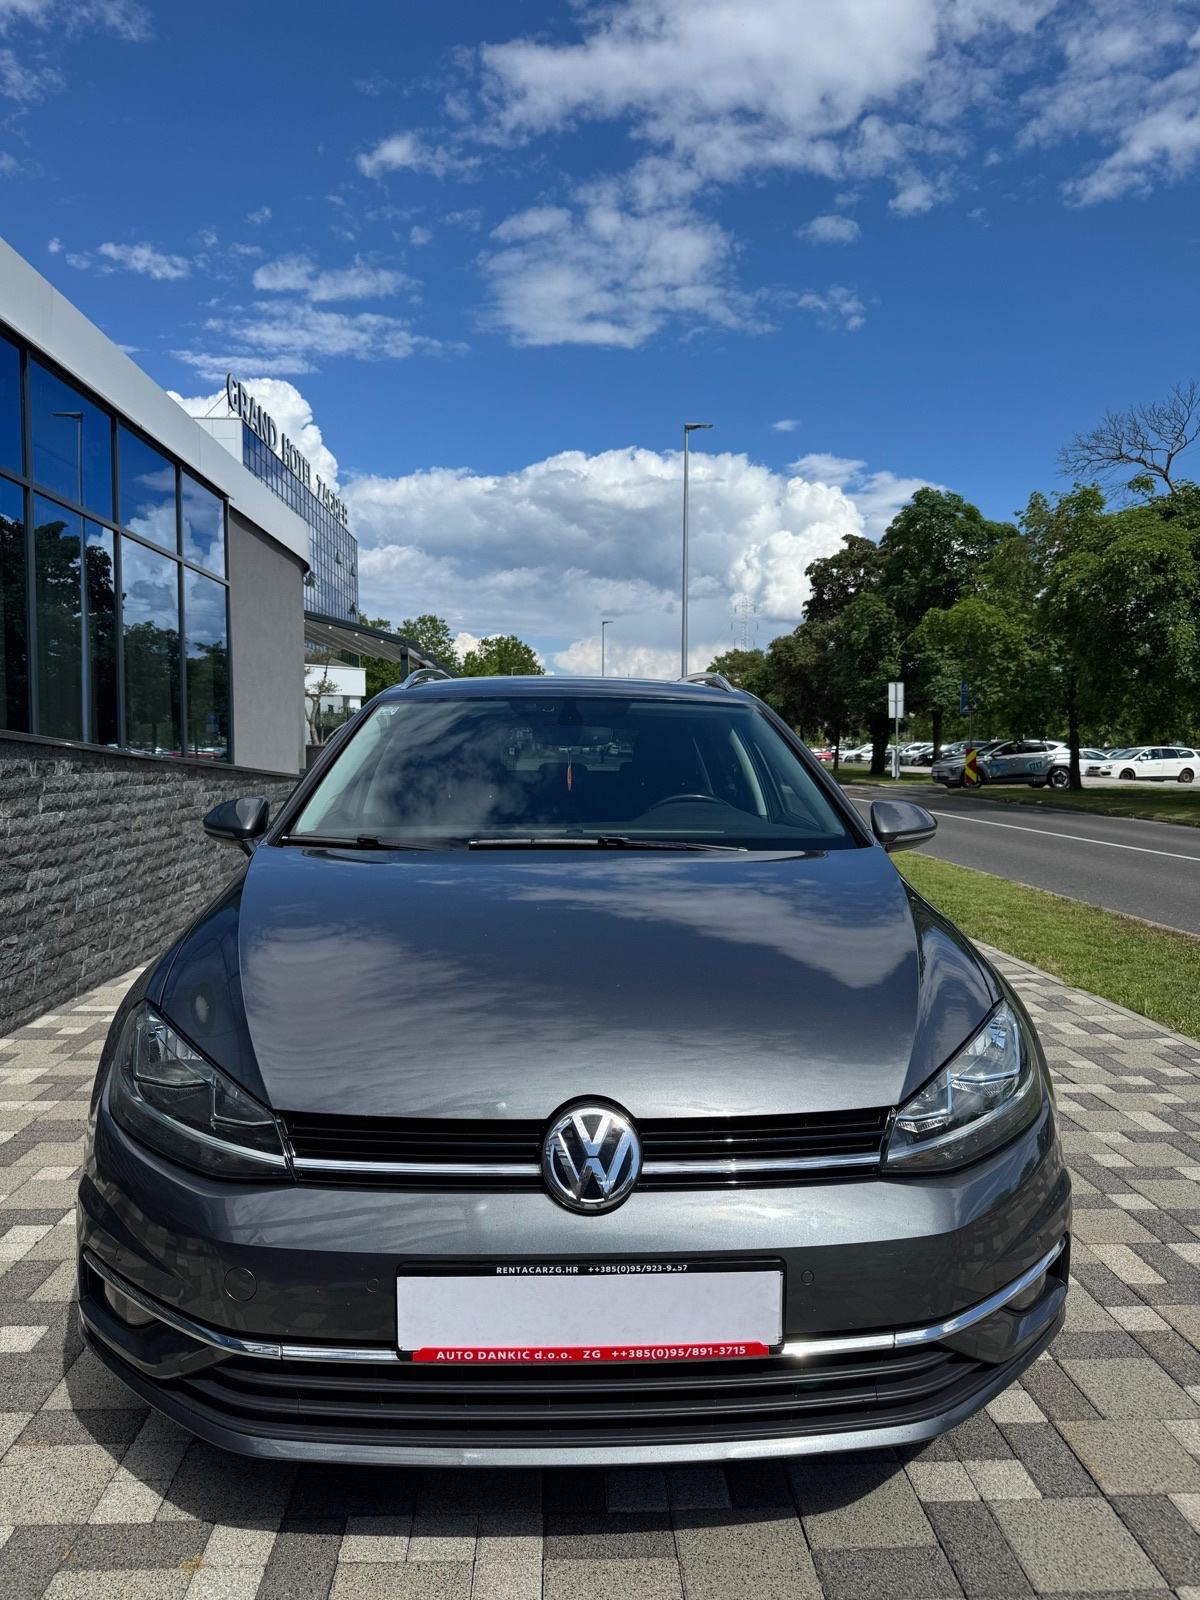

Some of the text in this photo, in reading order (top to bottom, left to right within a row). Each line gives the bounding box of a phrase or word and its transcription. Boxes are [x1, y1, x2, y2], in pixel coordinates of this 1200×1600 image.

[226, 373, 279, 453] GRAND
[496, 1266, 579, 1274] RENTACARZG.HR
[436, 1351, 474, 1360] AUTO
[534, 1350, 572, 1360] d.o.o.
[583, 1350, 601, 1359] ZG
[611, 1346, 746, 1360] ++385(0)95/891-3715
